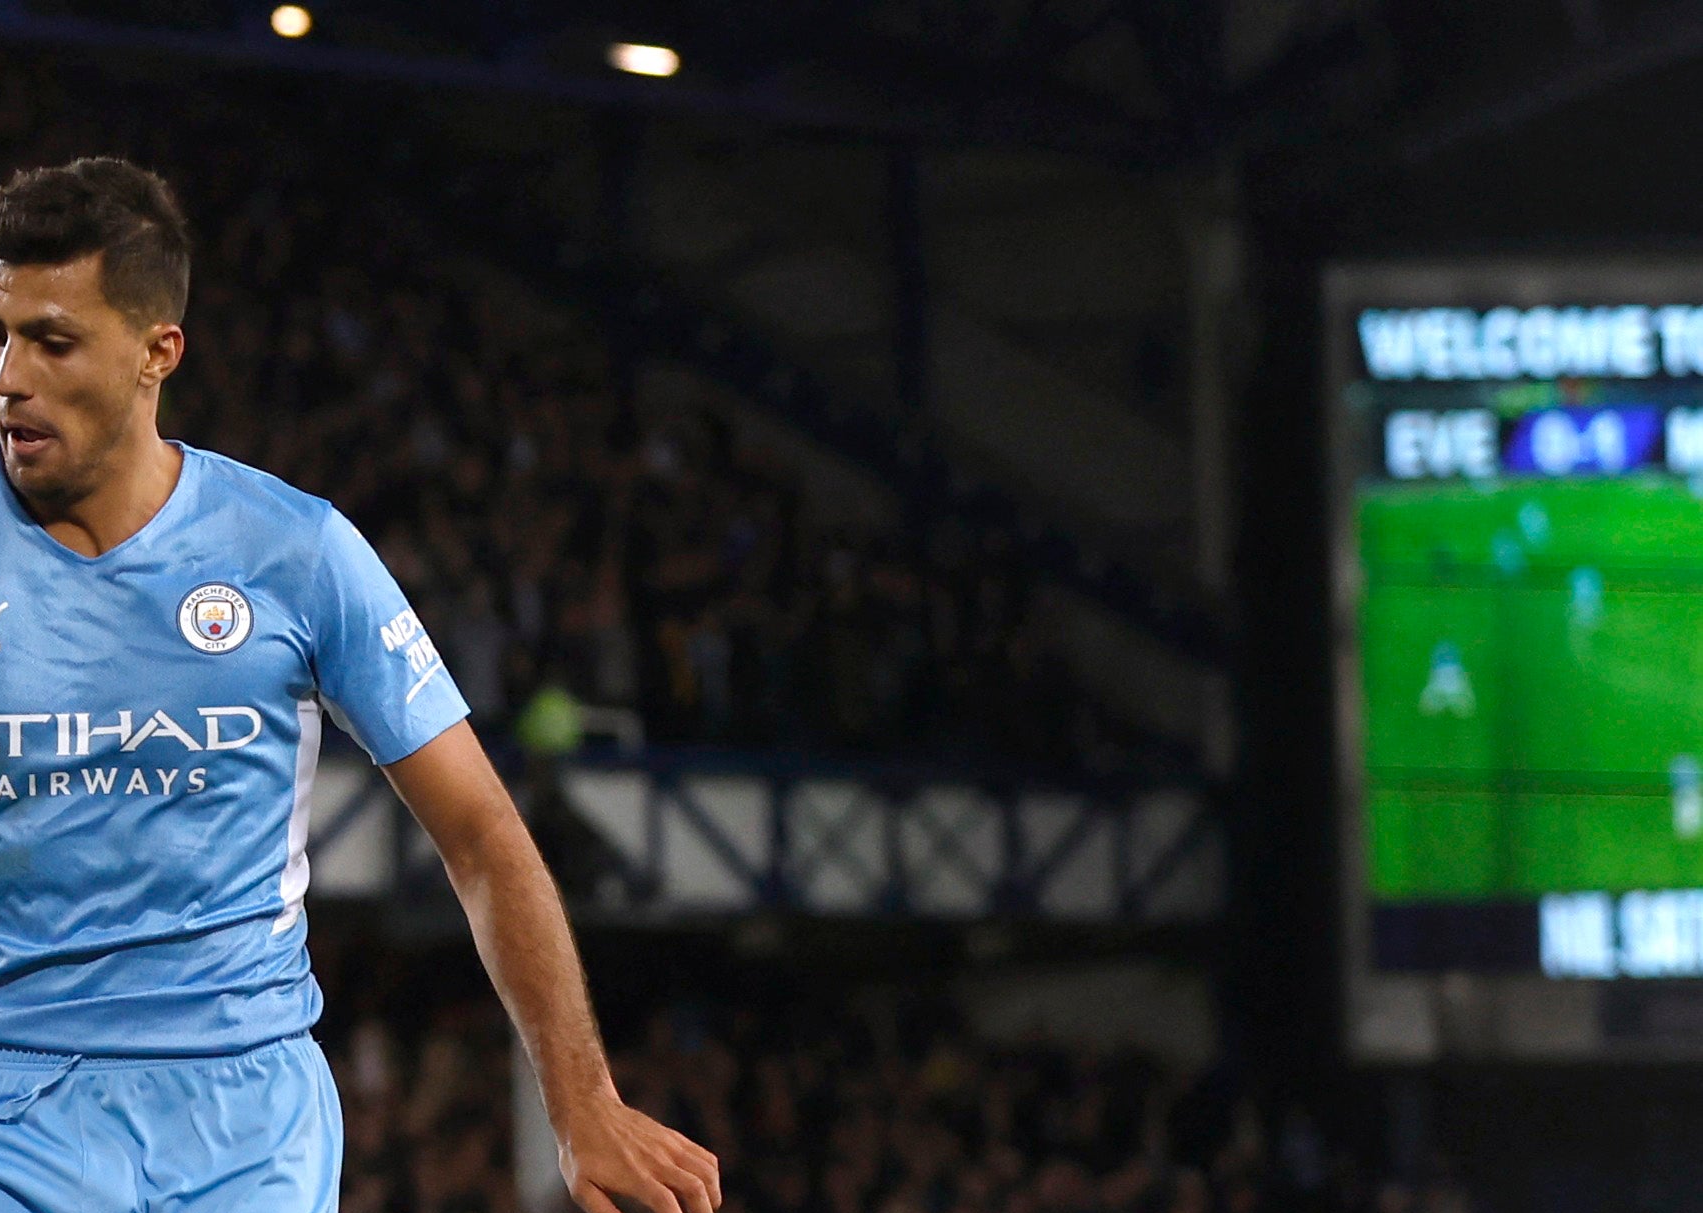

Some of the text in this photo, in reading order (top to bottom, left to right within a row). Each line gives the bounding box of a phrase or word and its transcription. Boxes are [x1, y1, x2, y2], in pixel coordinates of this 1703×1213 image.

[1359, 305, 1654, 380] WELCOME
[1385, 408, 1496, 478] EVE
[186, 588, 245, 610] MANCHESTER
[205, 642, 227, 650] CITY
